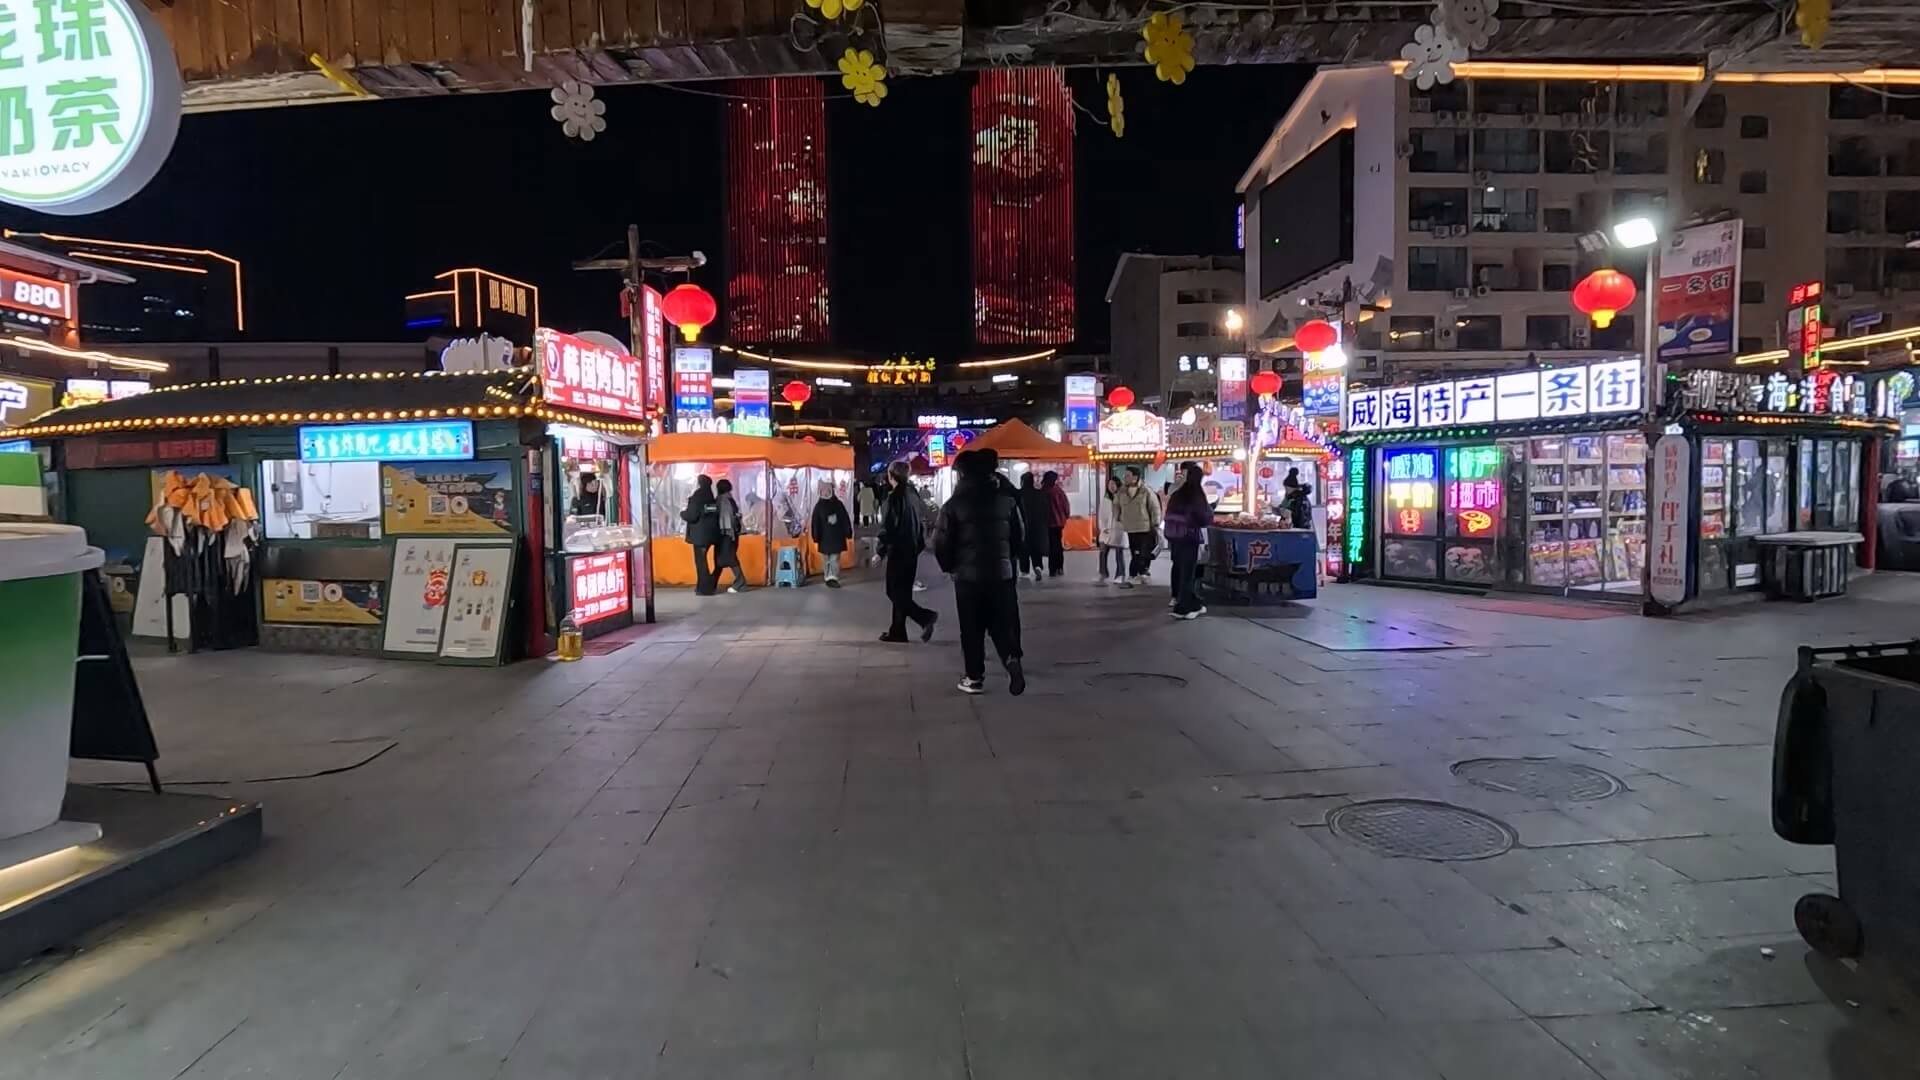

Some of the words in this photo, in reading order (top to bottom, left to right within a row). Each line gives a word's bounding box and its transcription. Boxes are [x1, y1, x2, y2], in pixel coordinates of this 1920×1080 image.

[15, 281, 62, 308] BBQ
[1351, 368, 1634, 427] 威海特产一条街
[1391, 453, 1433, 479] 威海
